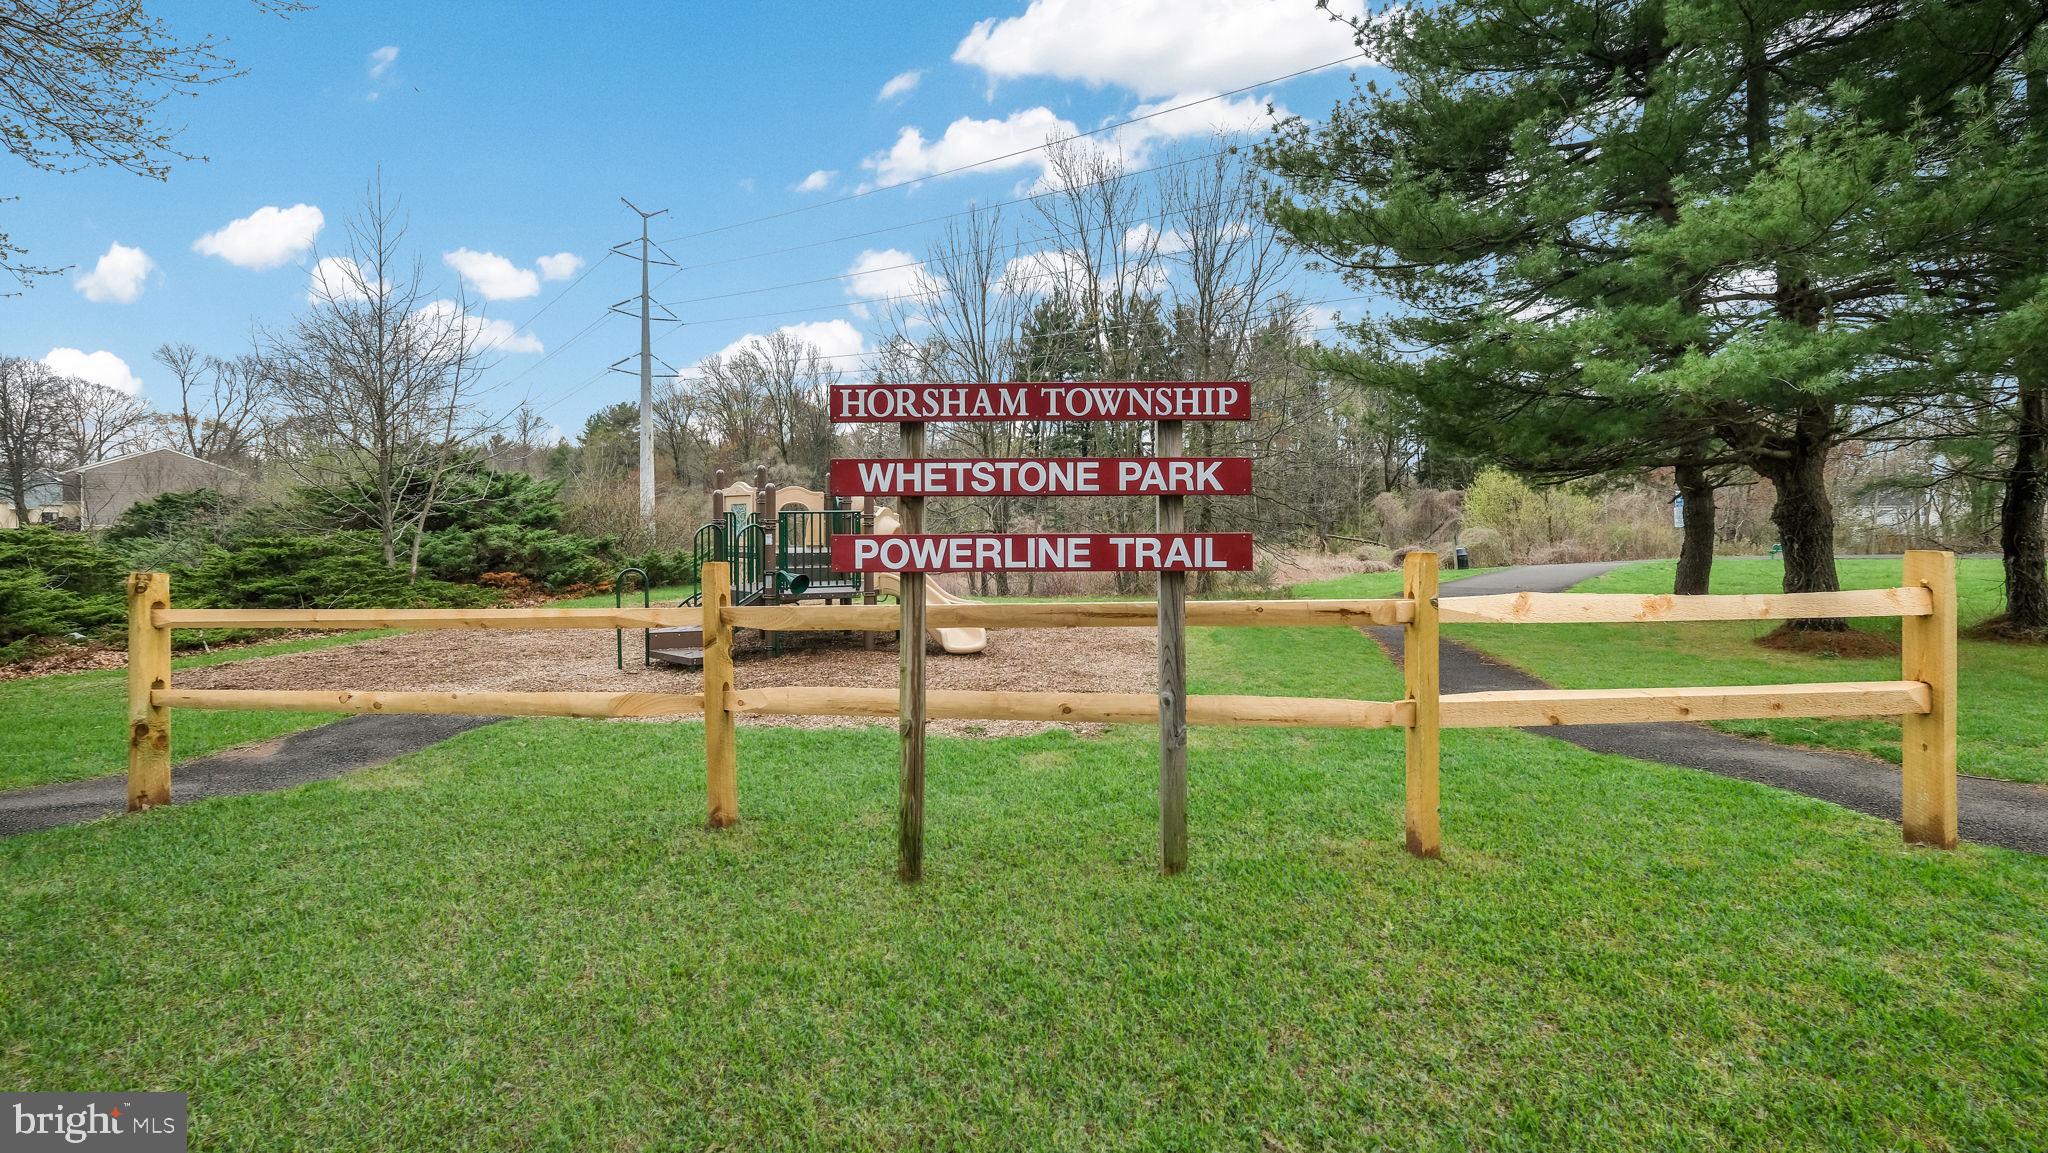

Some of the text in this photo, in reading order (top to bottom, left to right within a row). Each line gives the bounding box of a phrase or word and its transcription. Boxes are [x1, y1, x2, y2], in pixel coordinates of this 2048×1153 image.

[840, 387, 1238, 418] HORSHAM TOWNSHIP
[858, 461, 1224, 493] WHETSTONE PARK
[855, 537, 1227, 569] POWERLINE TRAIL
